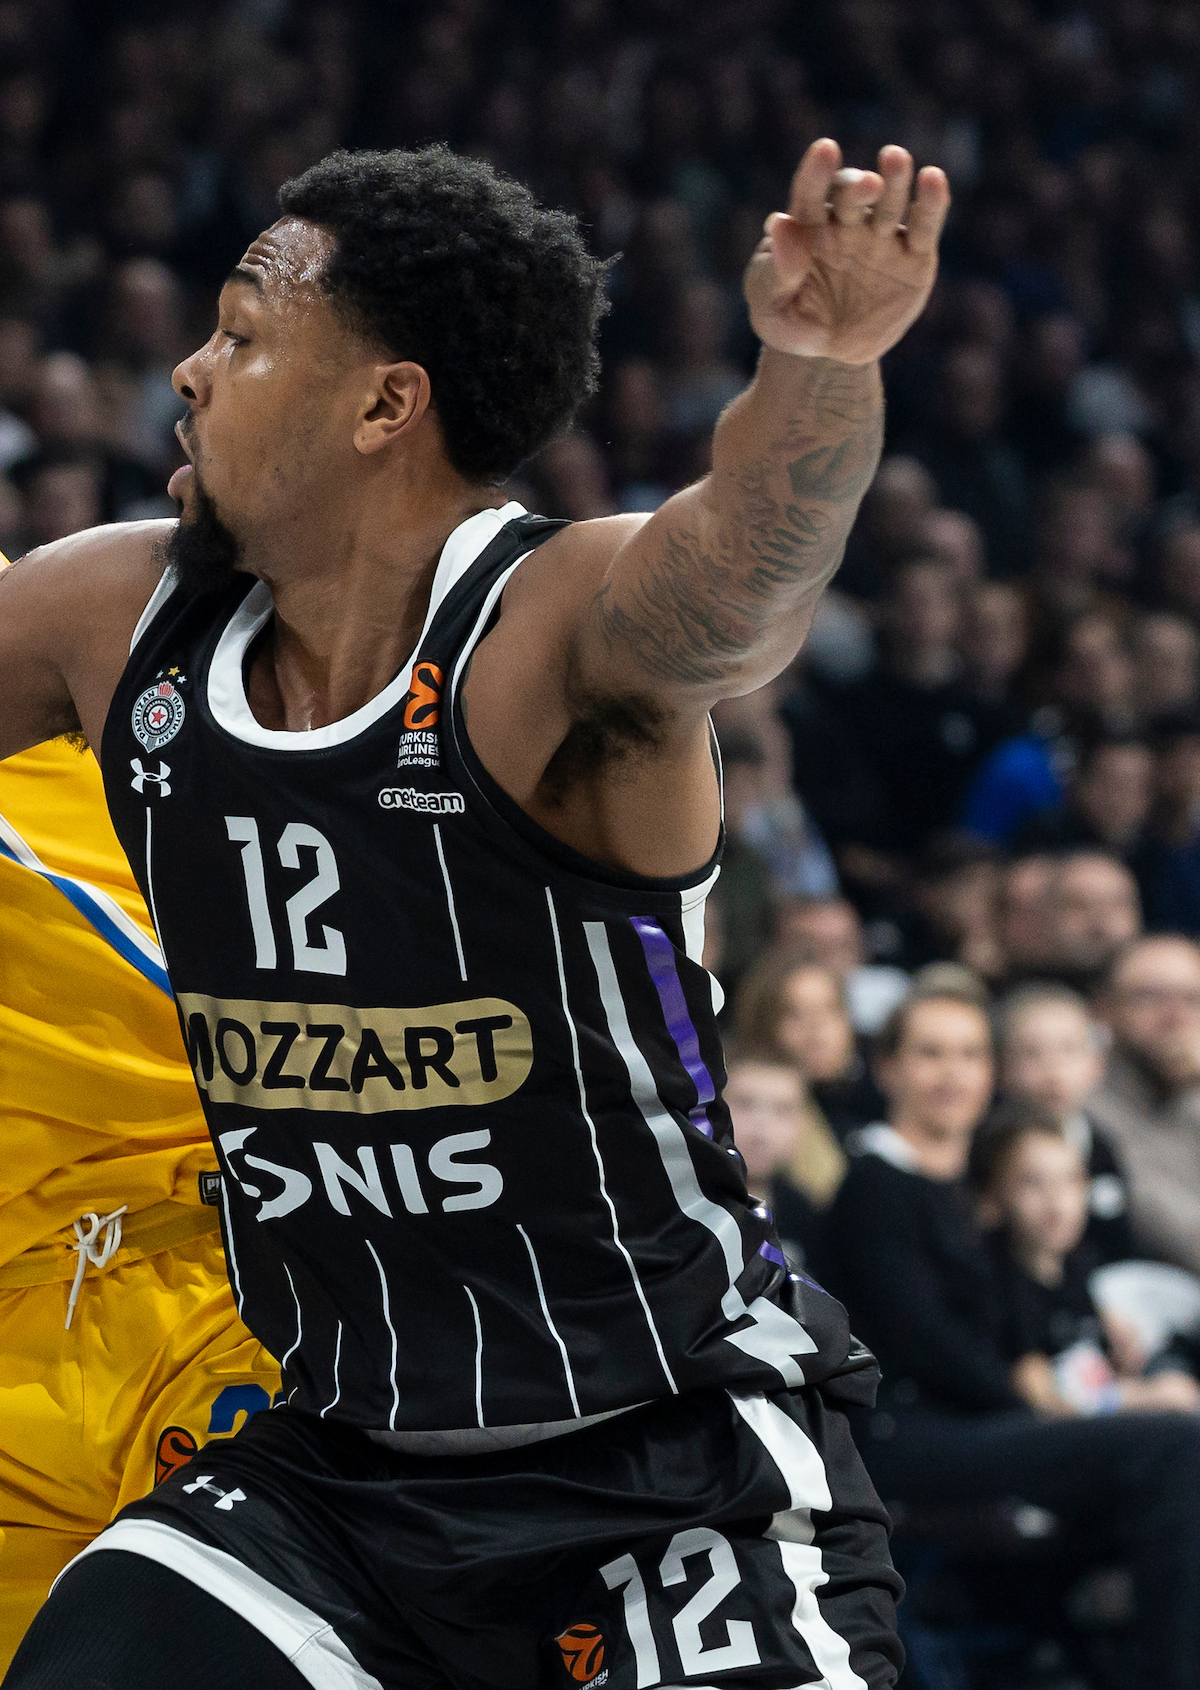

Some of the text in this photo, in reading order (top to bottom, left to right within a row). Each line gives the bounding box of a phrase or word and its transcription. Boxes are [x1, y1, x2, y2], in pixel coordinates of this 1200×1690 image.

[379, 788, 464, 813] oneteam
[224, 816, 347, 976] 12
[312, 1128, 504, 1219] NIS
[599, 1527, 762, 1689] 12
